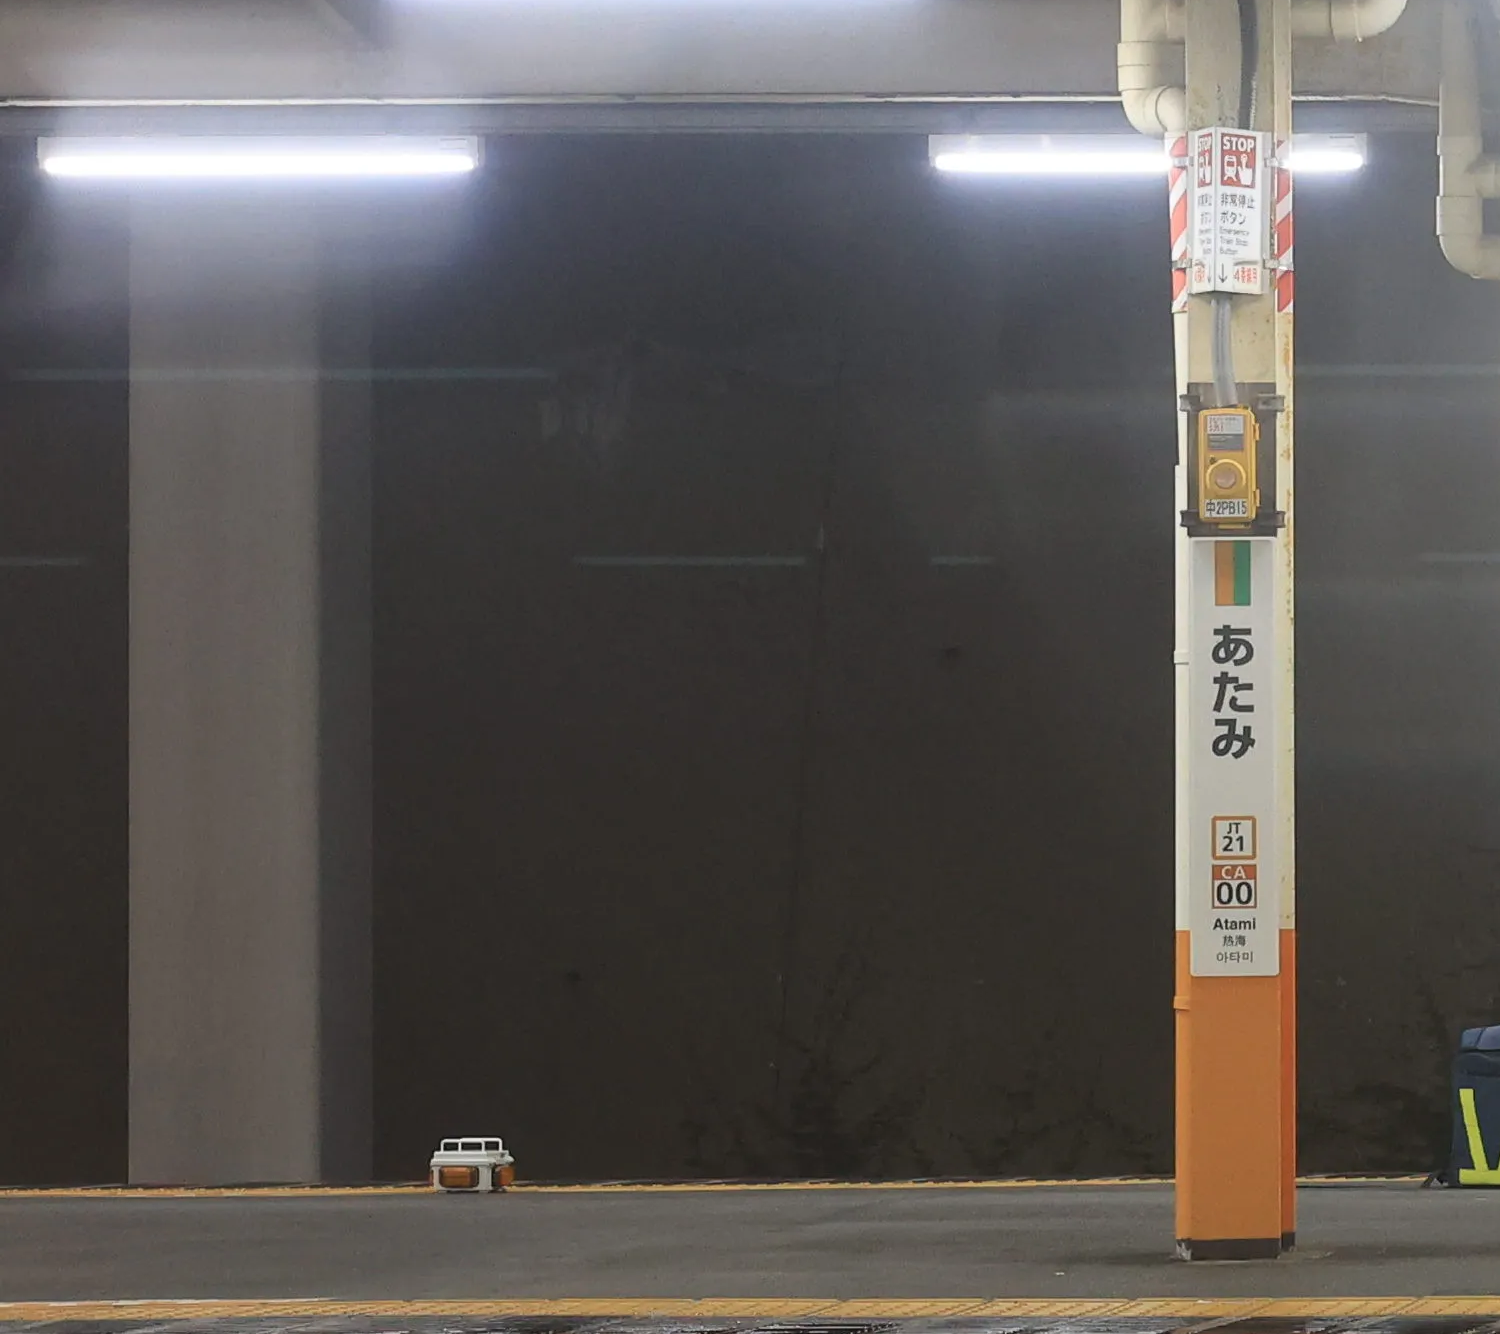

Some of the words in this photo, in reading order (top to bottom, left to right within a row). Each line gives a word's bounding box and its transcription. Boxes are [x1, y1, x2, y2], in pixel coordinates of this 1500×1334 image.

[1223, 136, 1255, 153] STOP
[1220, 193, 1256, 210] 非常停止
[1220, 211, 1246, 225] ボタン
[1211, 625, 1256, 760] あたみ
[1226, 822, 1241, 835] JT
[1222, 835, 1245, 853] 21
[1221, 865, 1246, 880] CA
[1215, 881, 1254, 906] 00
[1213, 917, 1256, 931] Atami
[1216, 951, 1254, 964] 아타미
